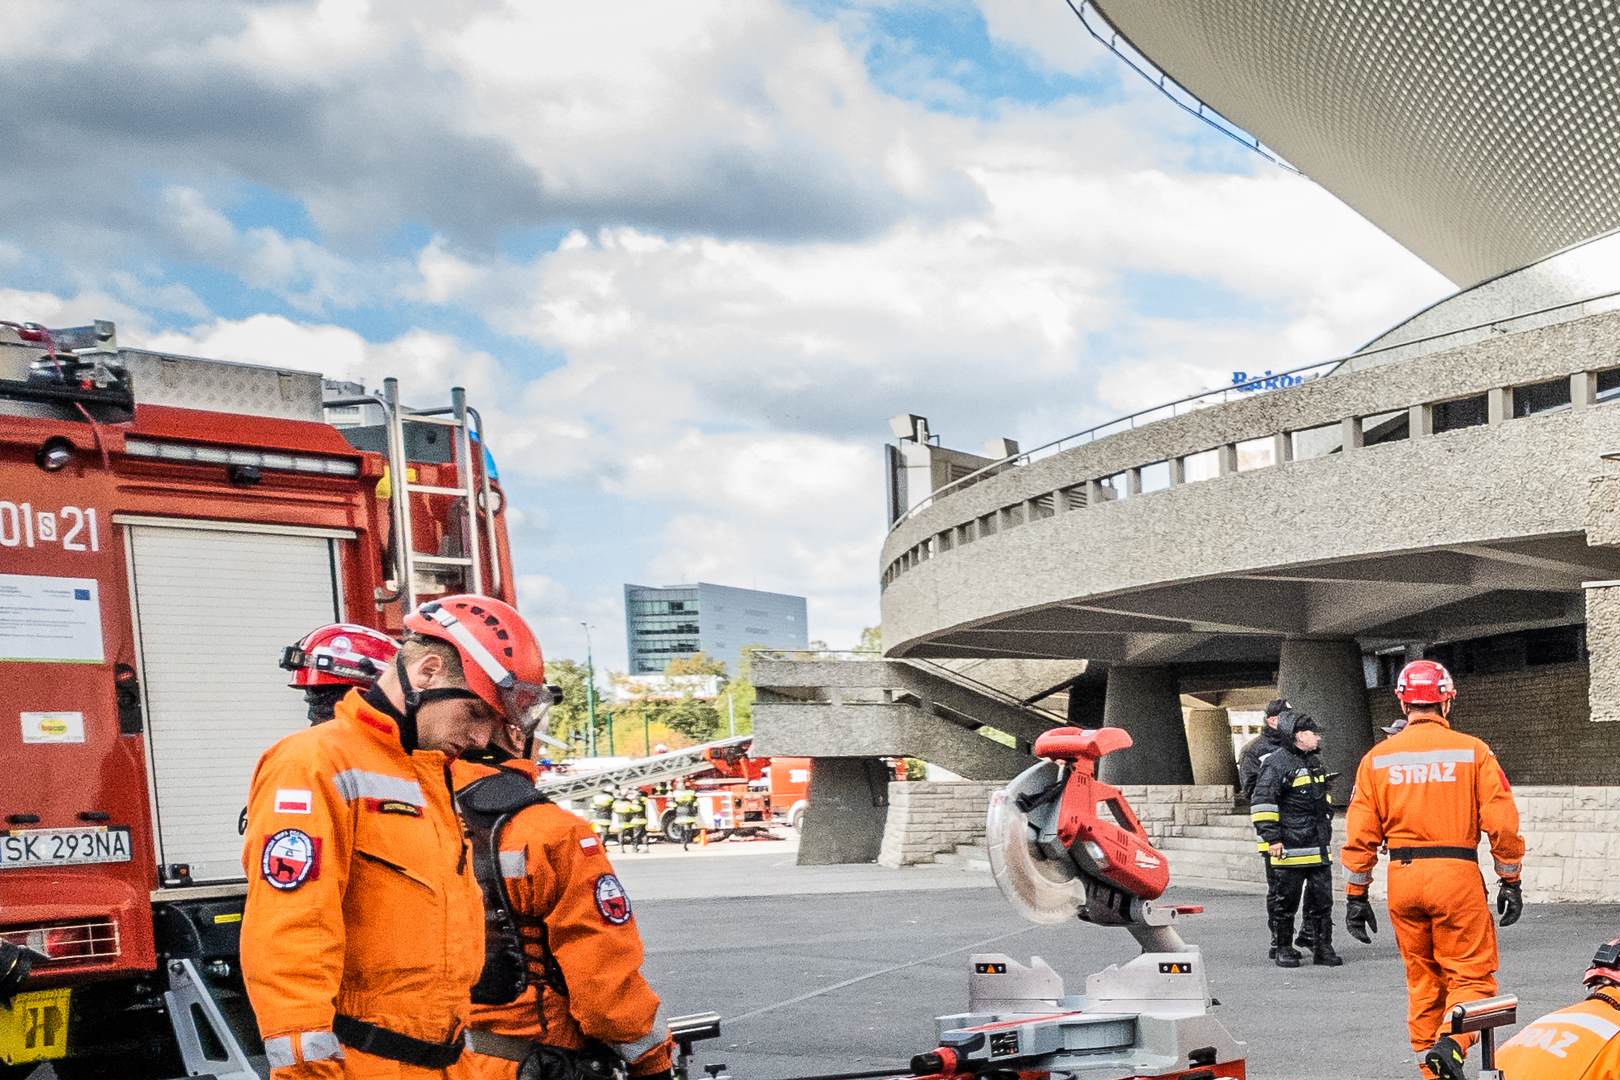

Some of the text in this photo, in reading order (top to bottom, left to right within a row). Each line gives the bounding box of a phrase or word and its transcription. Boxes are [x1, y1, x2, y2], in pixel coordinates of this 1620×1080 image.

[60, 506, 99, 551] 21
[5, 831, 126, 861] SK 293NA
